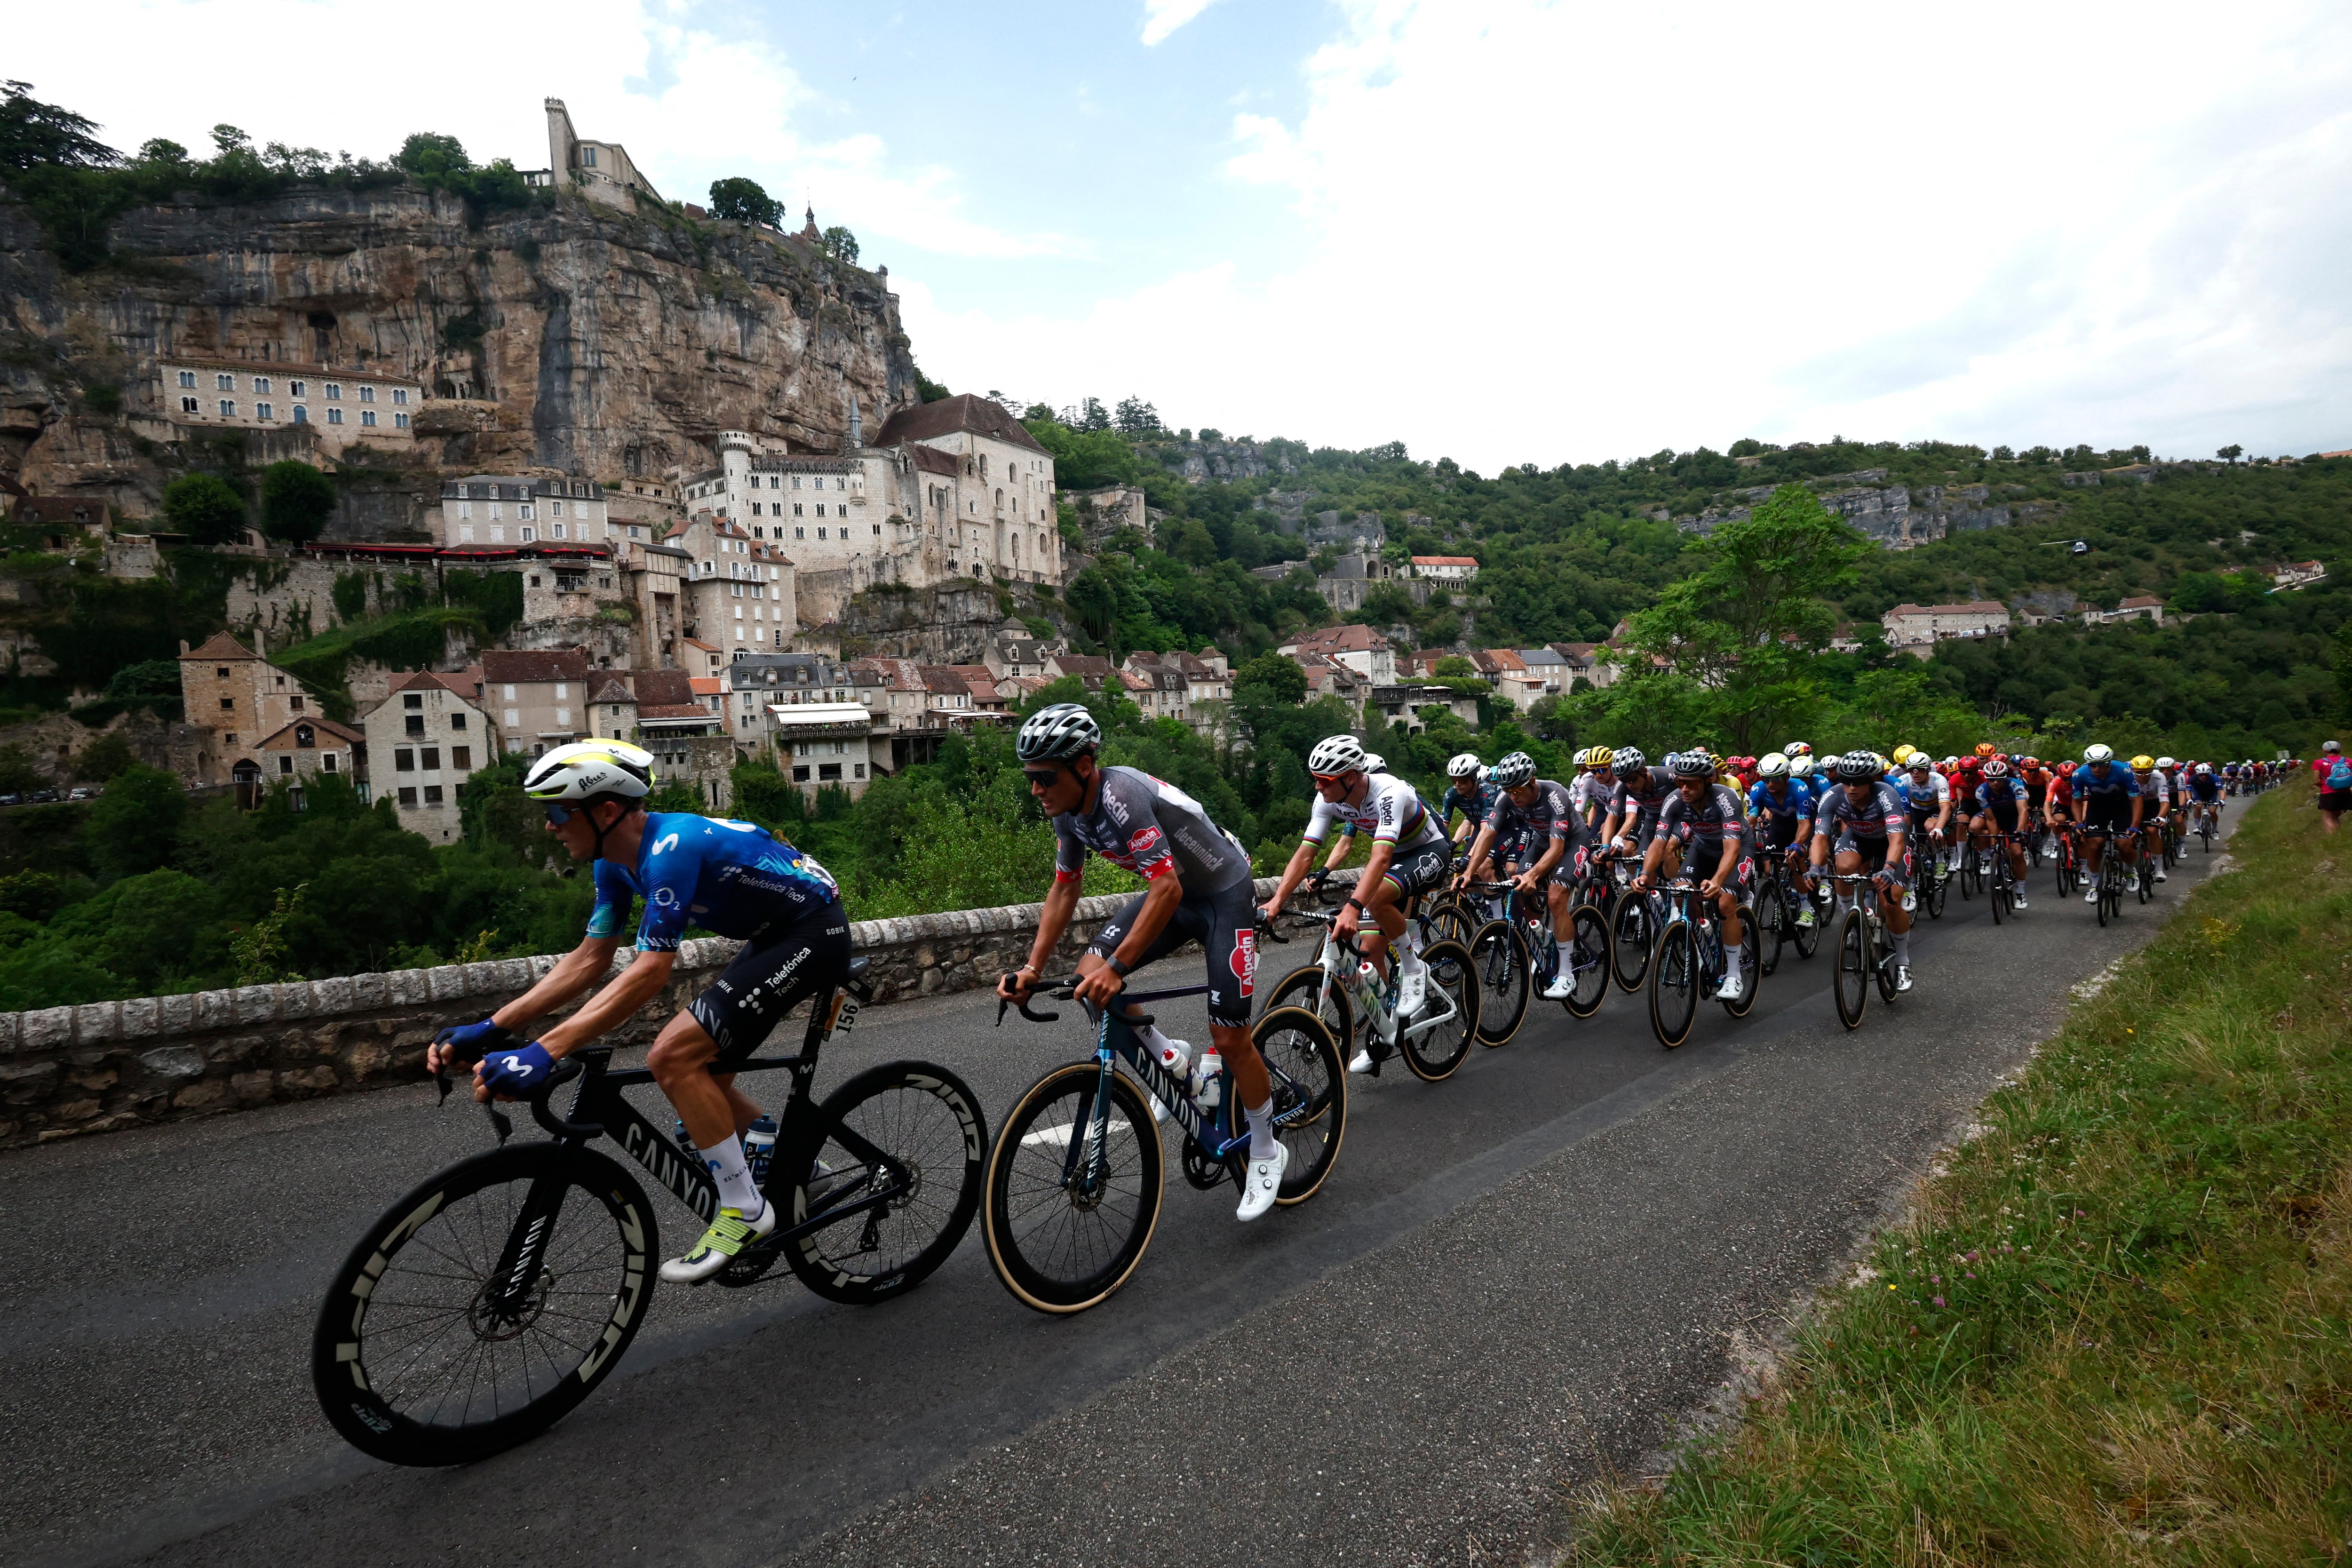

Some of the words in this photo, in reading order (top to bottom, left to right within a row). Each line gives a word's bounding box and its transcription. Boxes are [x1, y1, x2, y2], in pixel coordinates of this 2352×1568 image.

[1062, 738, 1089, 758] CANYON
[1336, 762, 1355, 774] CANYON
[578, 772, 607, 791] Abus
[1382, 796, 1394, 826] Alpecin
[1548, 790, 1565, 814] Alpecin
[1717, 793, 1735, 817] Alpecin
[1877, 790, 1893, 812] Alpecin
[1130, 828, 1157, 849] Alpecin
[1173, 826, 1224, 872] deceuninck
[1519, 831, 1528, 844] VISMA
[1420, 857, 1439, 880] Alpecin
[1577, 851, 1588, 874] Alpecin
[1741, 860, 1753, 882] Alpecin
[738, 874, 786, 893] Telefónica
[783, 887, 806, 903] Tech
[1431, 893, 1434, 901] 6
[826, 926, 845, 935] GOBIK
[764, 946, 811, 988] Telefónica
[1242, 936, 1253, 986] Alpecin
[1580, 963, 1596, 972] CANYON
[716, 979, 734, 994] GOBIK
[774, 976, 800, 997] Tech
[690, 998, 733, 1050] NYO
[836, 1004, 858, 1034] 156
[1275, 1067, 1291, 1082] SHIMANO
[568, 1082, 582, 1115] CANYON
[1136, 1047, 1199, 1140] CANYON
[905, 1074, 980, 1161] ZIPP
[1275, 1107, 1305, 1126] CANYON
[1087, 1116, 1104, 1179] CANYON
[504, 1215, 547, 1297] CANYON
[578, 1203, 645, 1383] ZIPP
[873, 1276, 904, 1291] ZIPP
[351, 1403, 388, 1434] ZIPP
